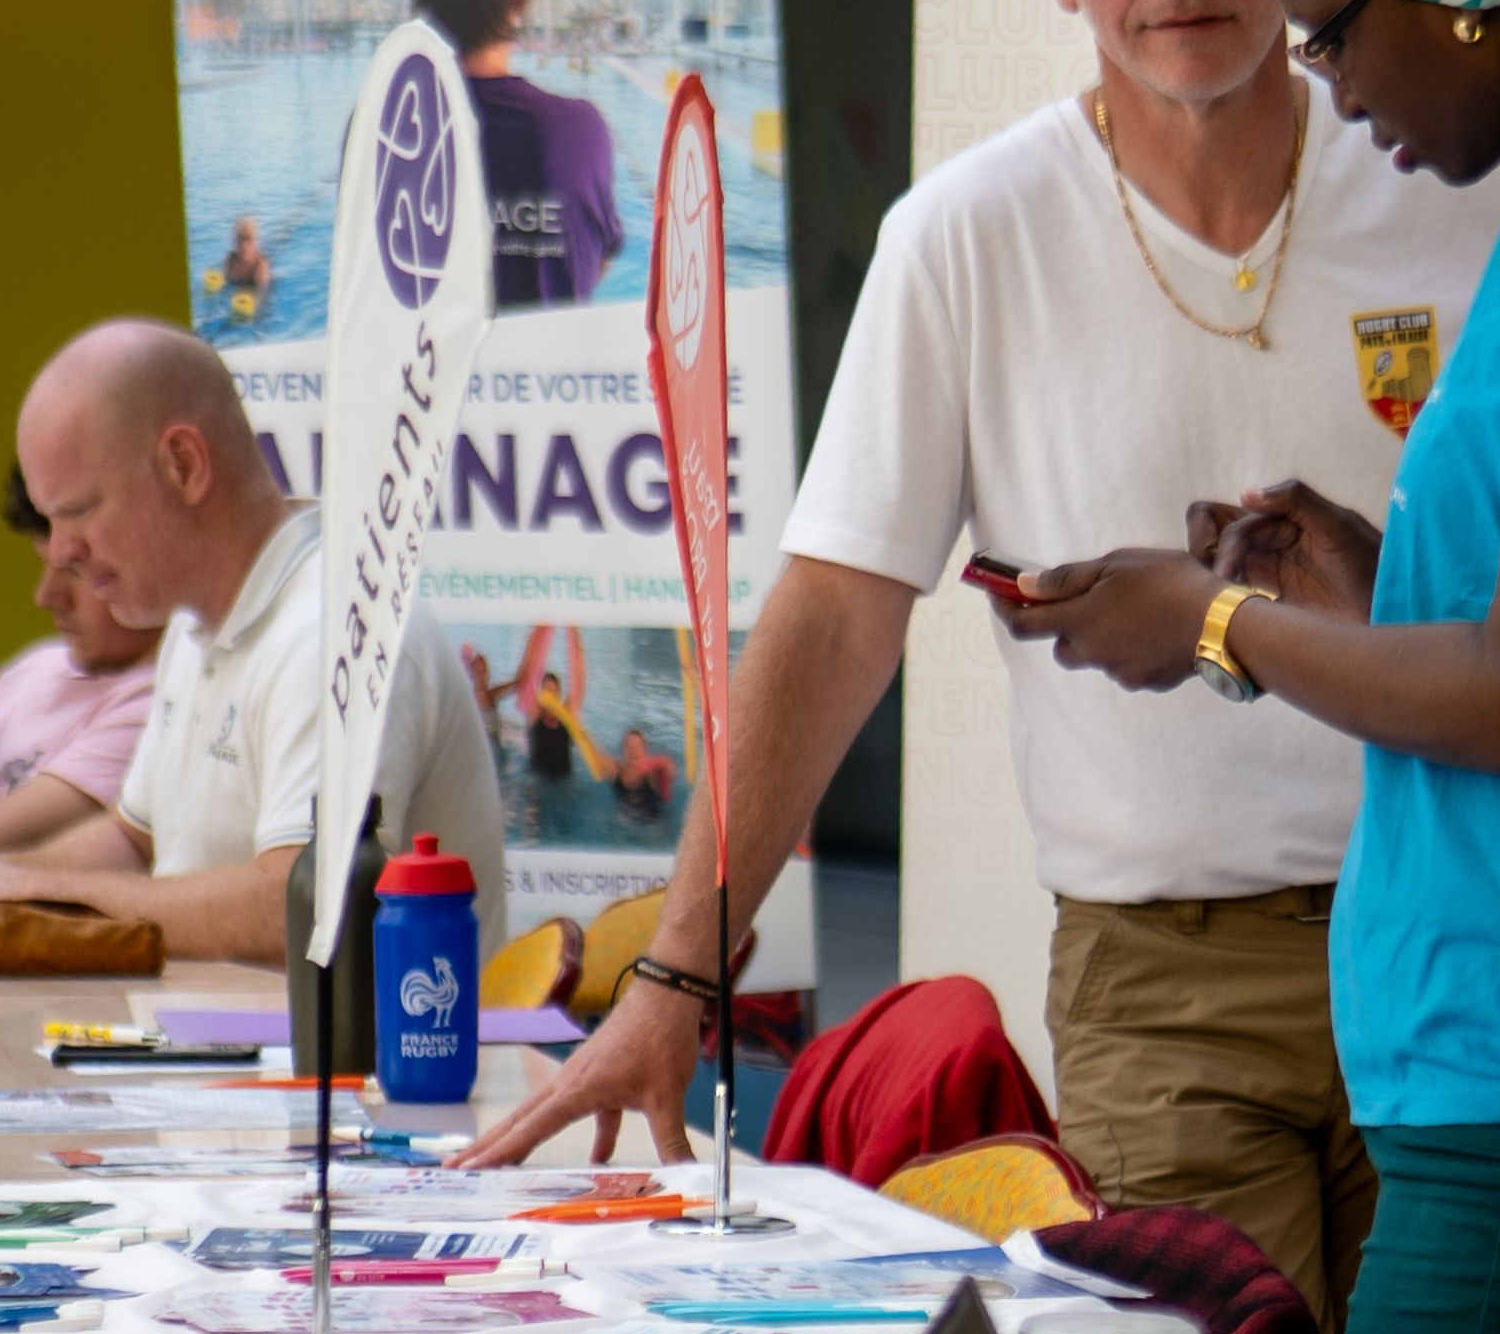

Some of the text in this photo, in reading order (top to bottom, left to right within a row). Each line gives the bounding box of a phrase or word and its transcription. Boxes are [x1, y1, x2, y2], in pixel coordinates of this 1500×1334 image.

[494, 372, 530, 404] DE
[538, 370, 644, 403] VOTRE
[331, 320, 439, 734] patients
[366, 640, 388, 712] EN
[400, 1033, 458, 1047] FRANCE
[401, 1045, 458, 1059] RUGBY
